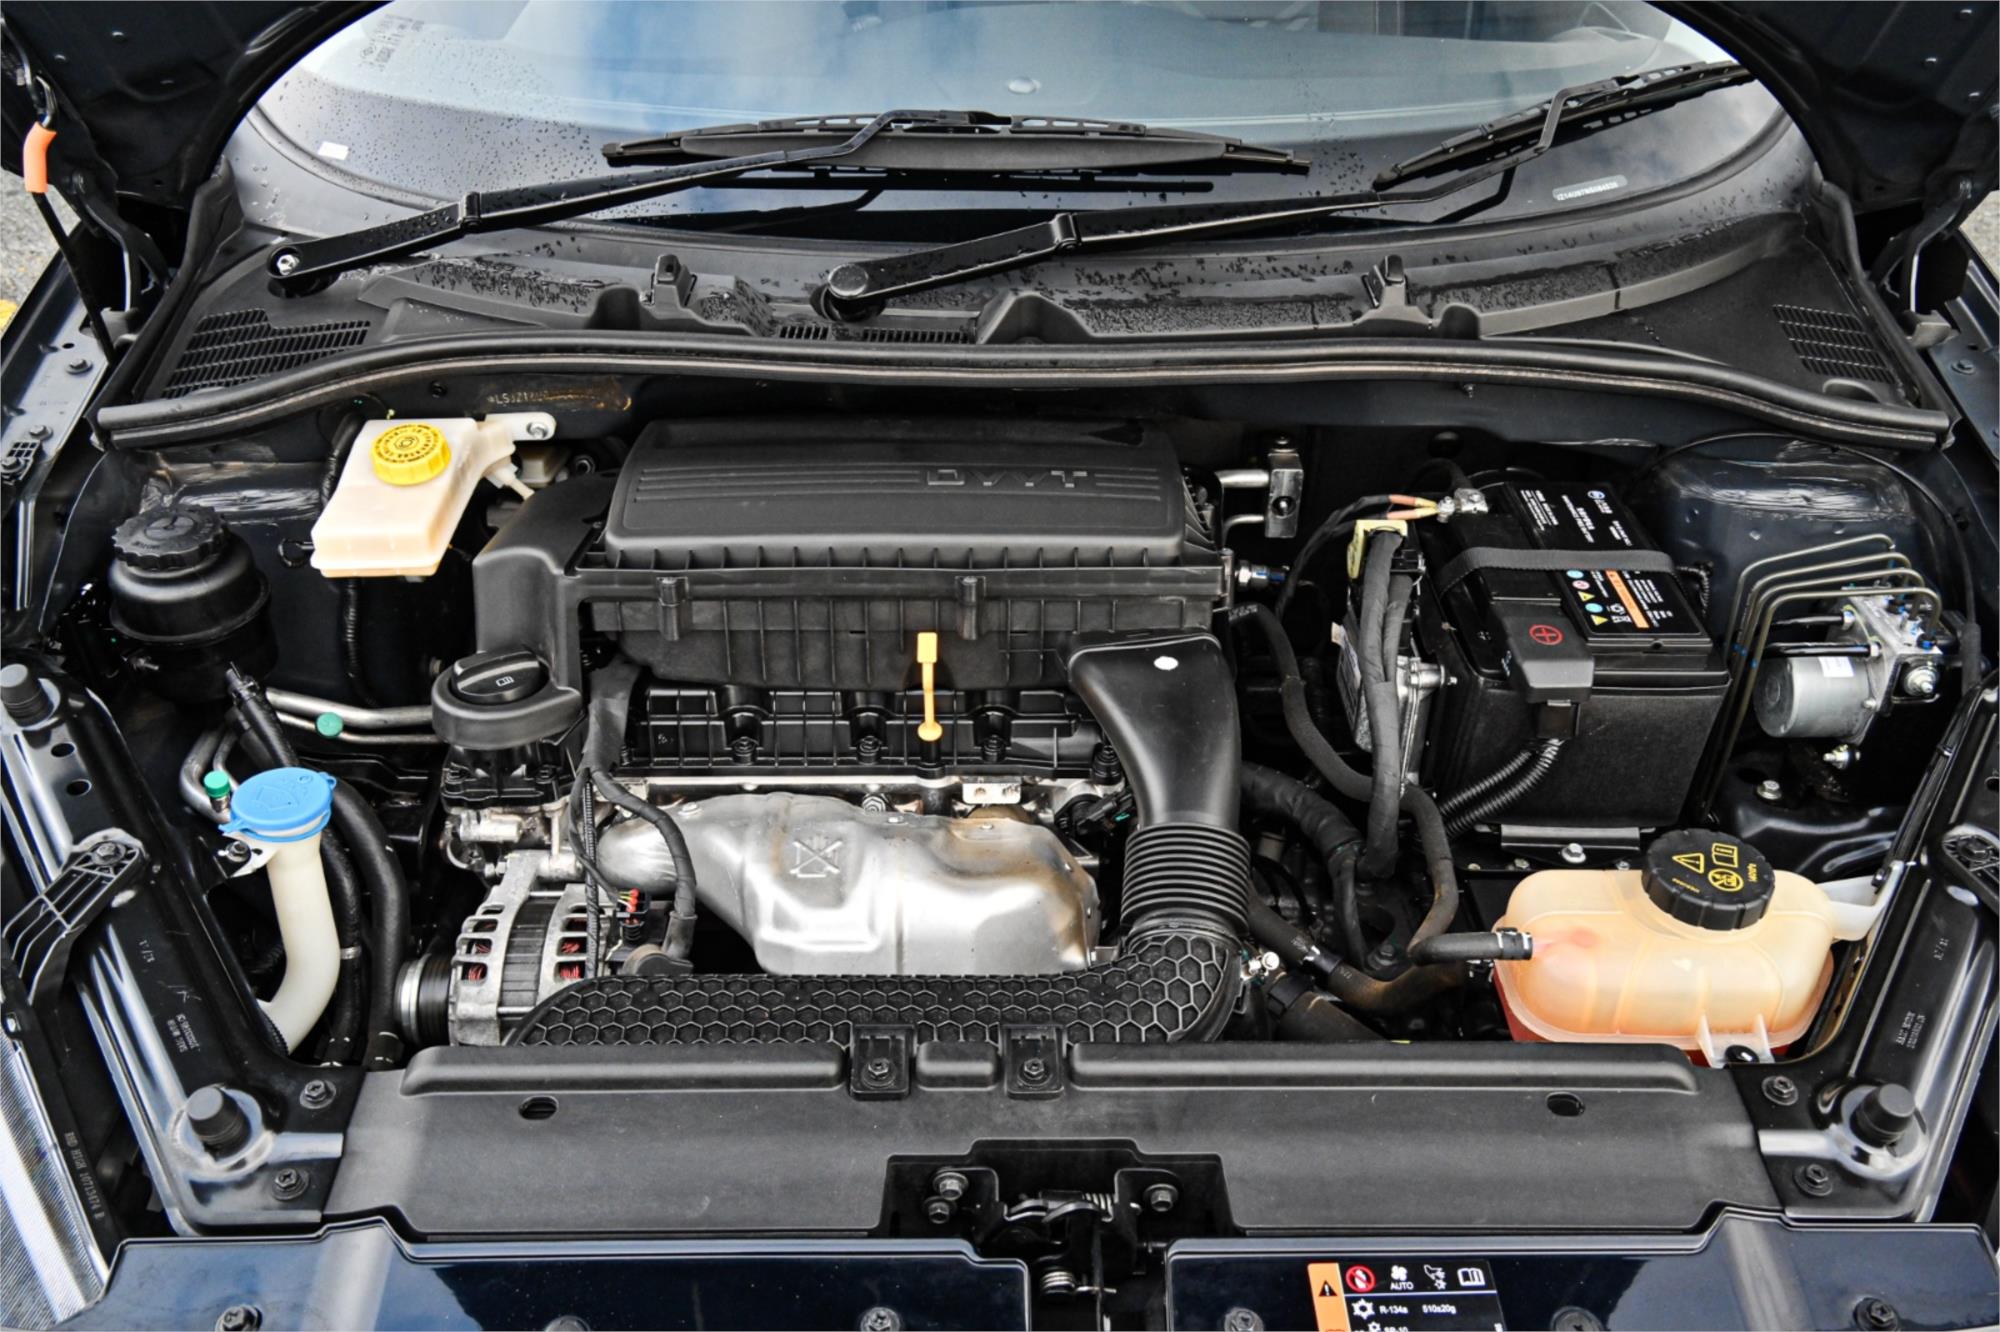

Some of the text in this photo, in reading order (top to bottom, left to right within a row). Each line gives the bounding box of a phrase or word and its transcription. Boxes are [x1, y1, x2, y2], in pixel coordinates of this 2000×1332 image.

[927, 469, 1088, 488] DVVT
[1390, 1281, 1414, 1291] AUTO
[1379, 1305, 1409, 1314] R-134a
